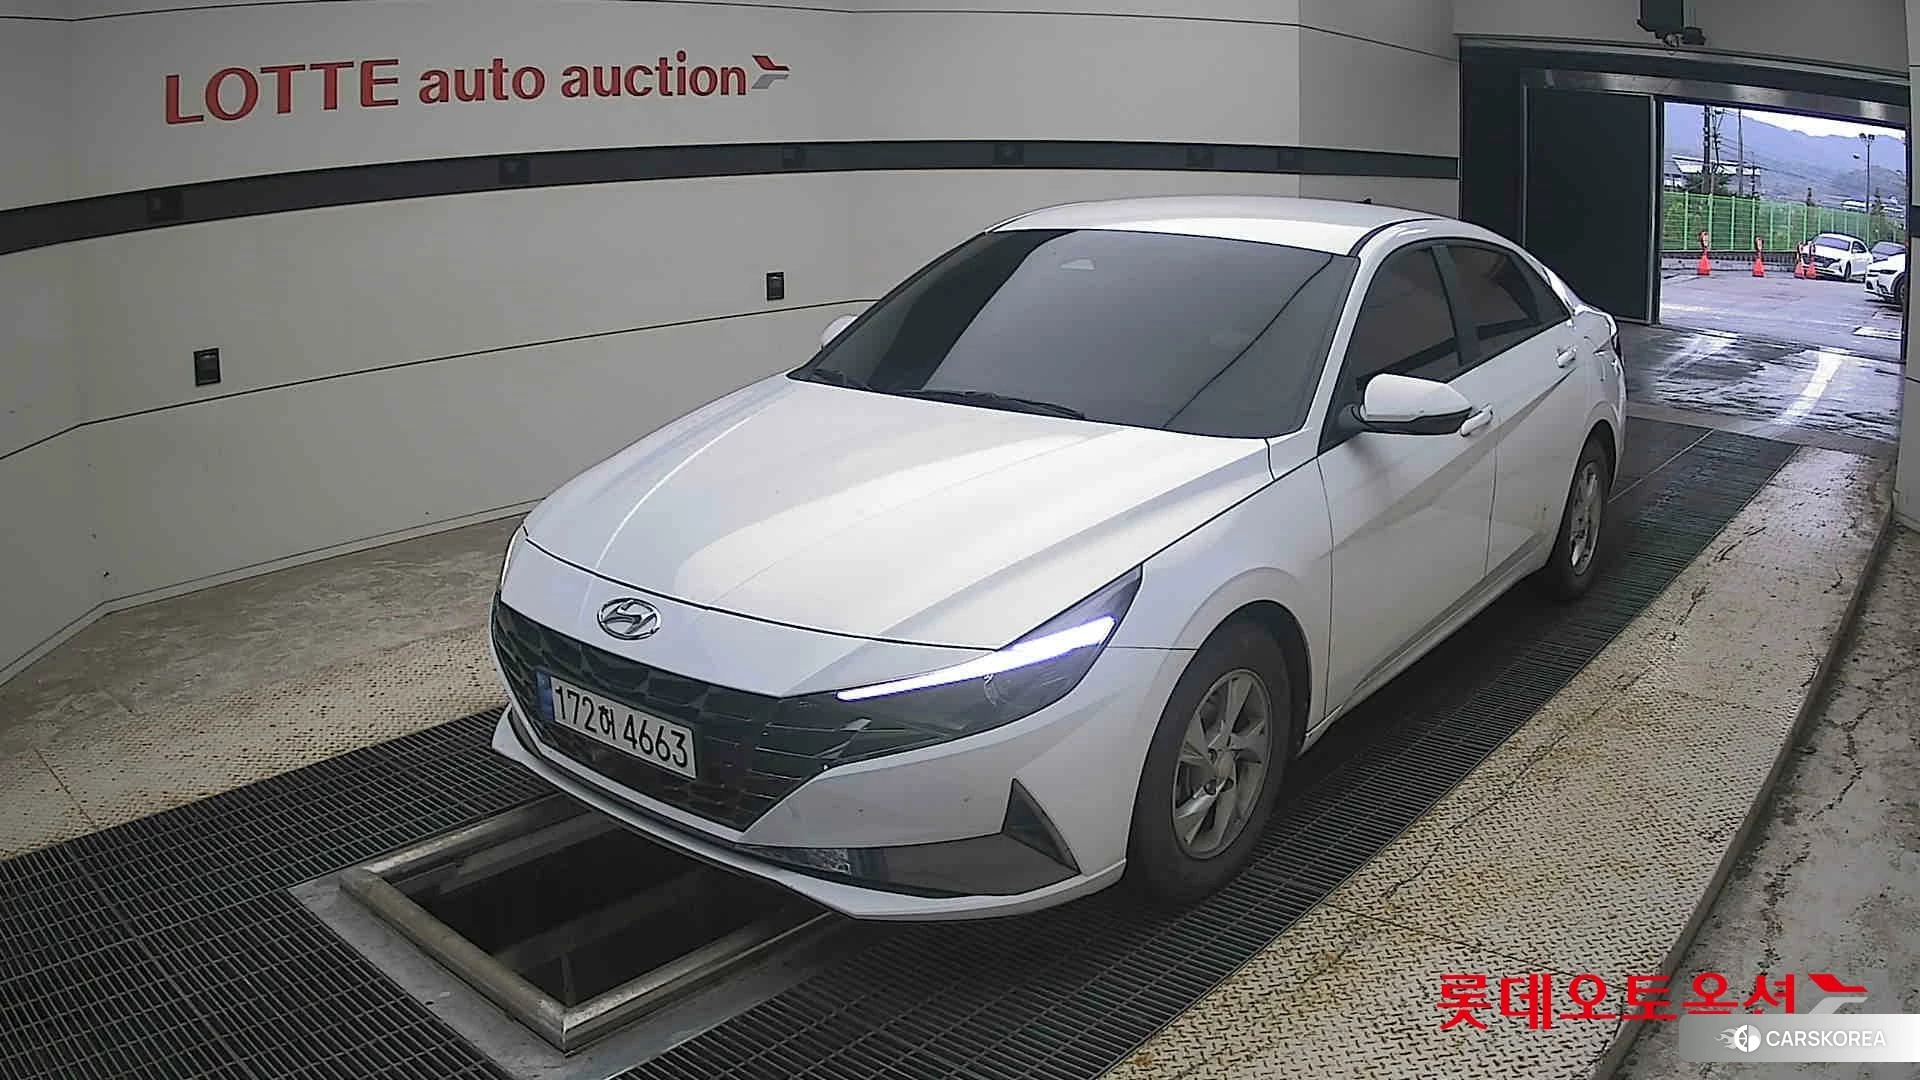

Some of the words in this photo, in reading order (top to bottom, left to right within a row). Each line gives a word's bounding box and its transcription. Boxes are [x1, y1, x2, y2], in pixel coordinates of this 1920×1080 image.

[165, 58, 399, 124] LOTTE
[418, 57, 546, 104] auto
[560, 50, 747, 98] auction
[623, 713, 688, 768] 4663
